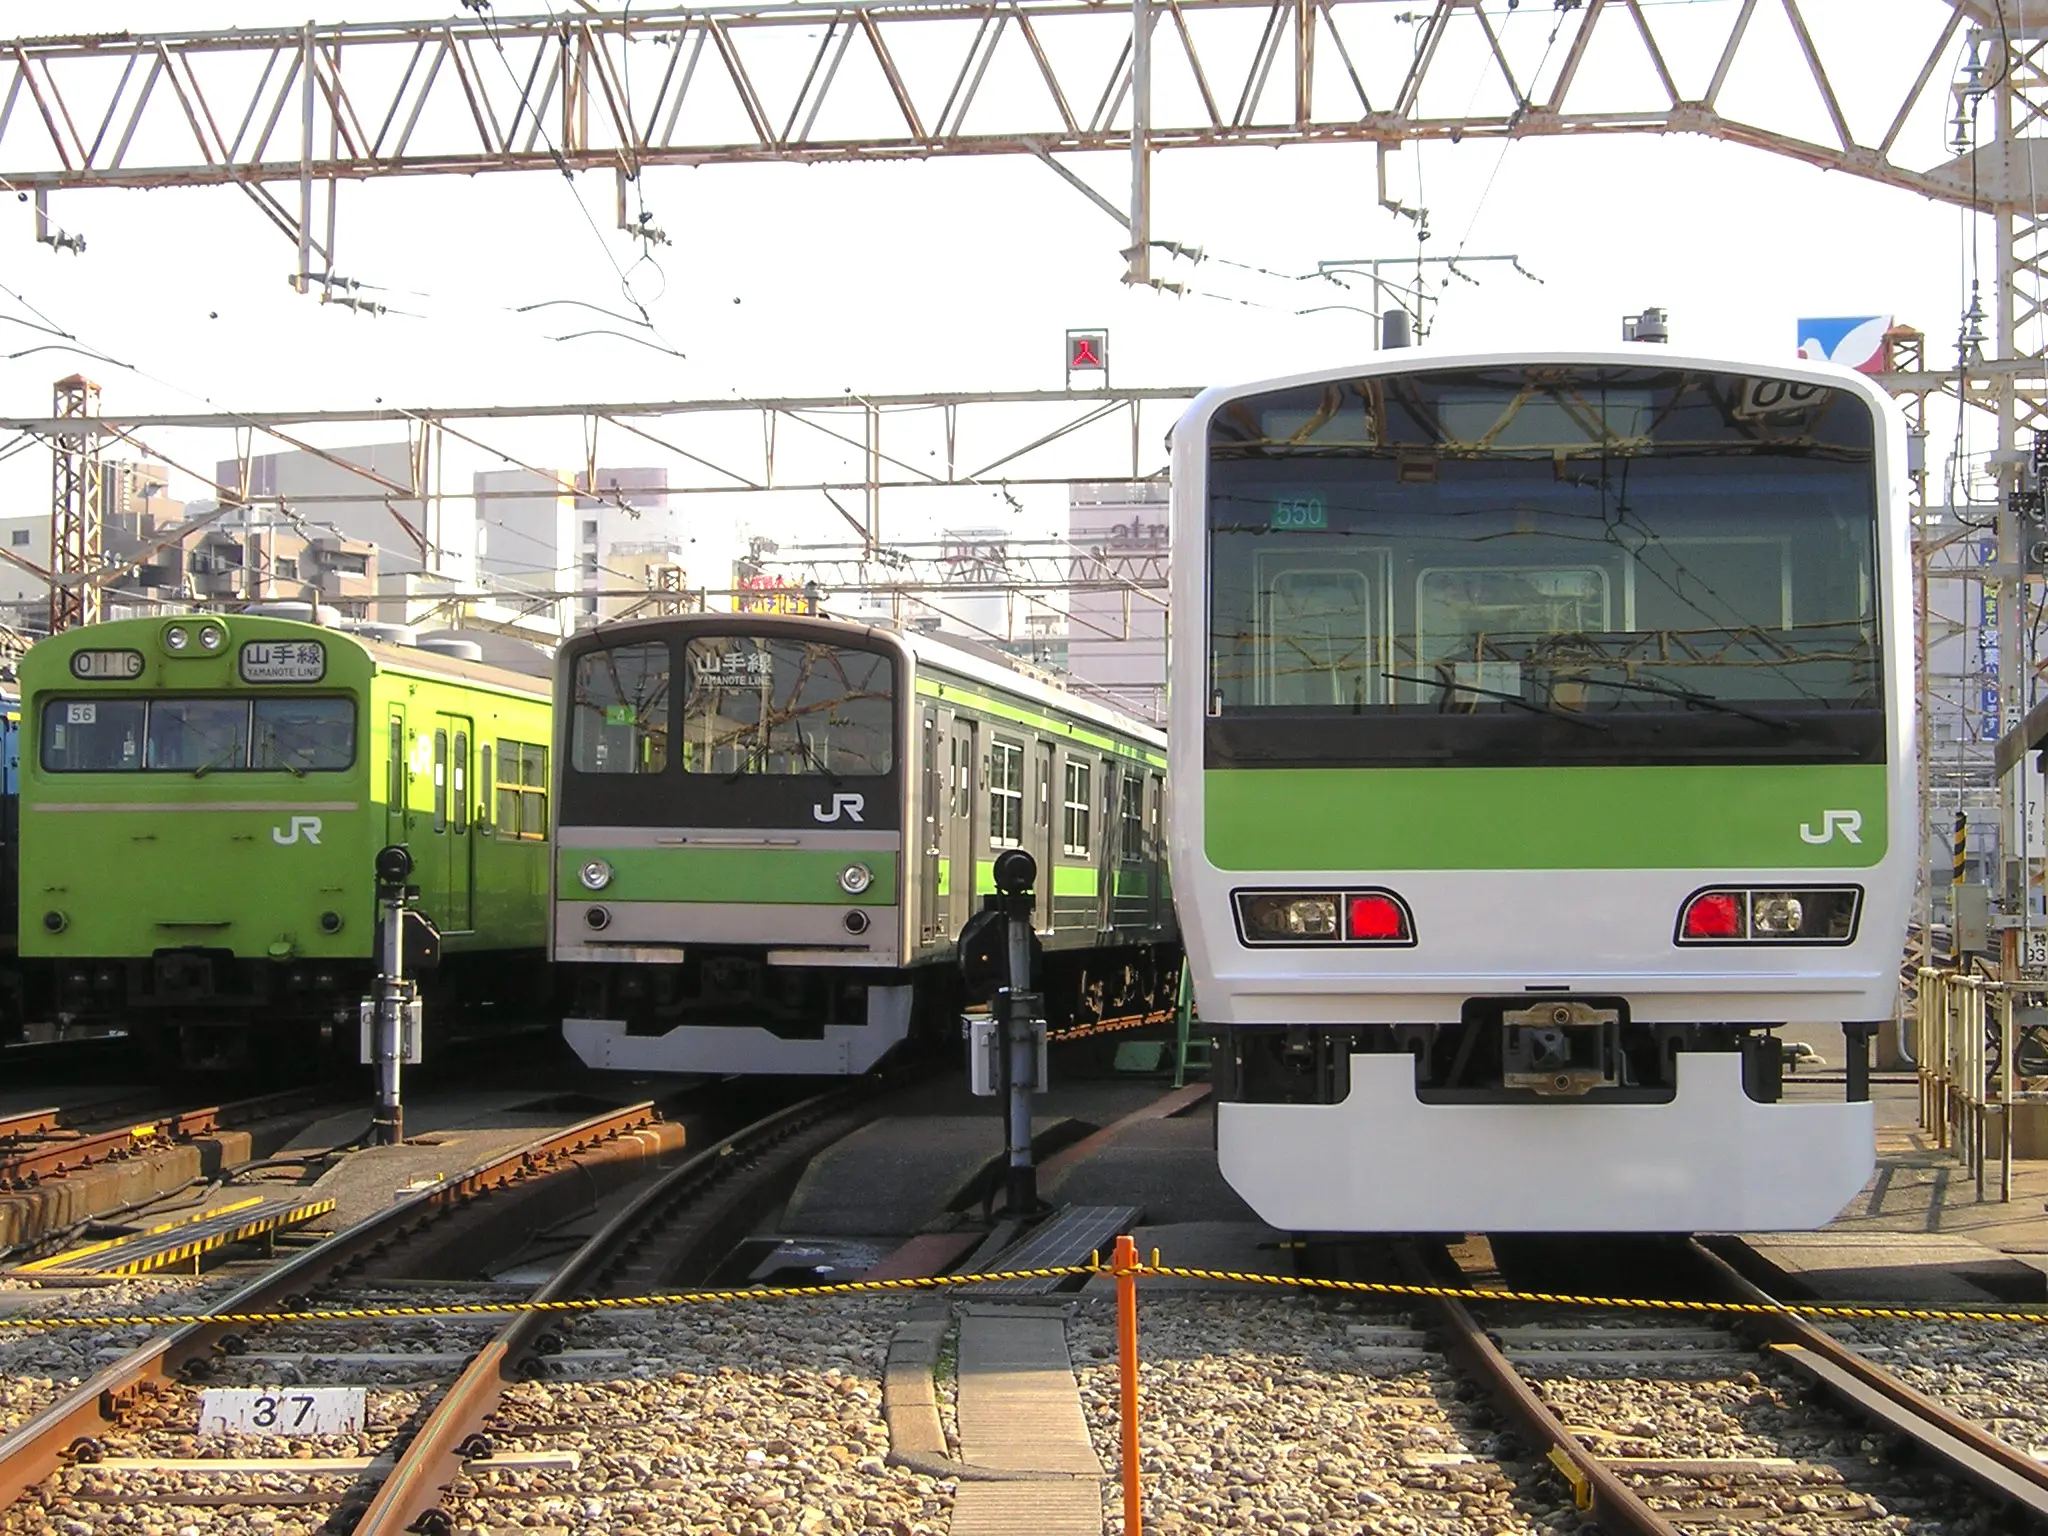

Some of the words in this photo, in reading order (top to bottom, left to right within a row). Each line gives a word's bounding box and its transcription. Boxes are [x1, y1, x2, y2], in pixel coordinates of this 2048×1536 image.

[1279, 499, 1321, 524] 550
[1111, 515, 1169, 548] atr
[247, 644, 321, 665] 山手線
[697, 652, 772, 673] 山手線
[247, 668, 296, 677] YAMANOTE
[298, 668, 319, 677] LINE
[699, 675, 746, 685] YAMANOTE
[748, 675, 771, 685] LINE
[71, 708, 92, 721] 56
[411, 735, 431, 775] JR
[814, 793, 864, 822] JR
[273, 816, 322, 845] JR
[1800, 810, 1862, 844] JR
[253, 1396, 315, 1428] 37
